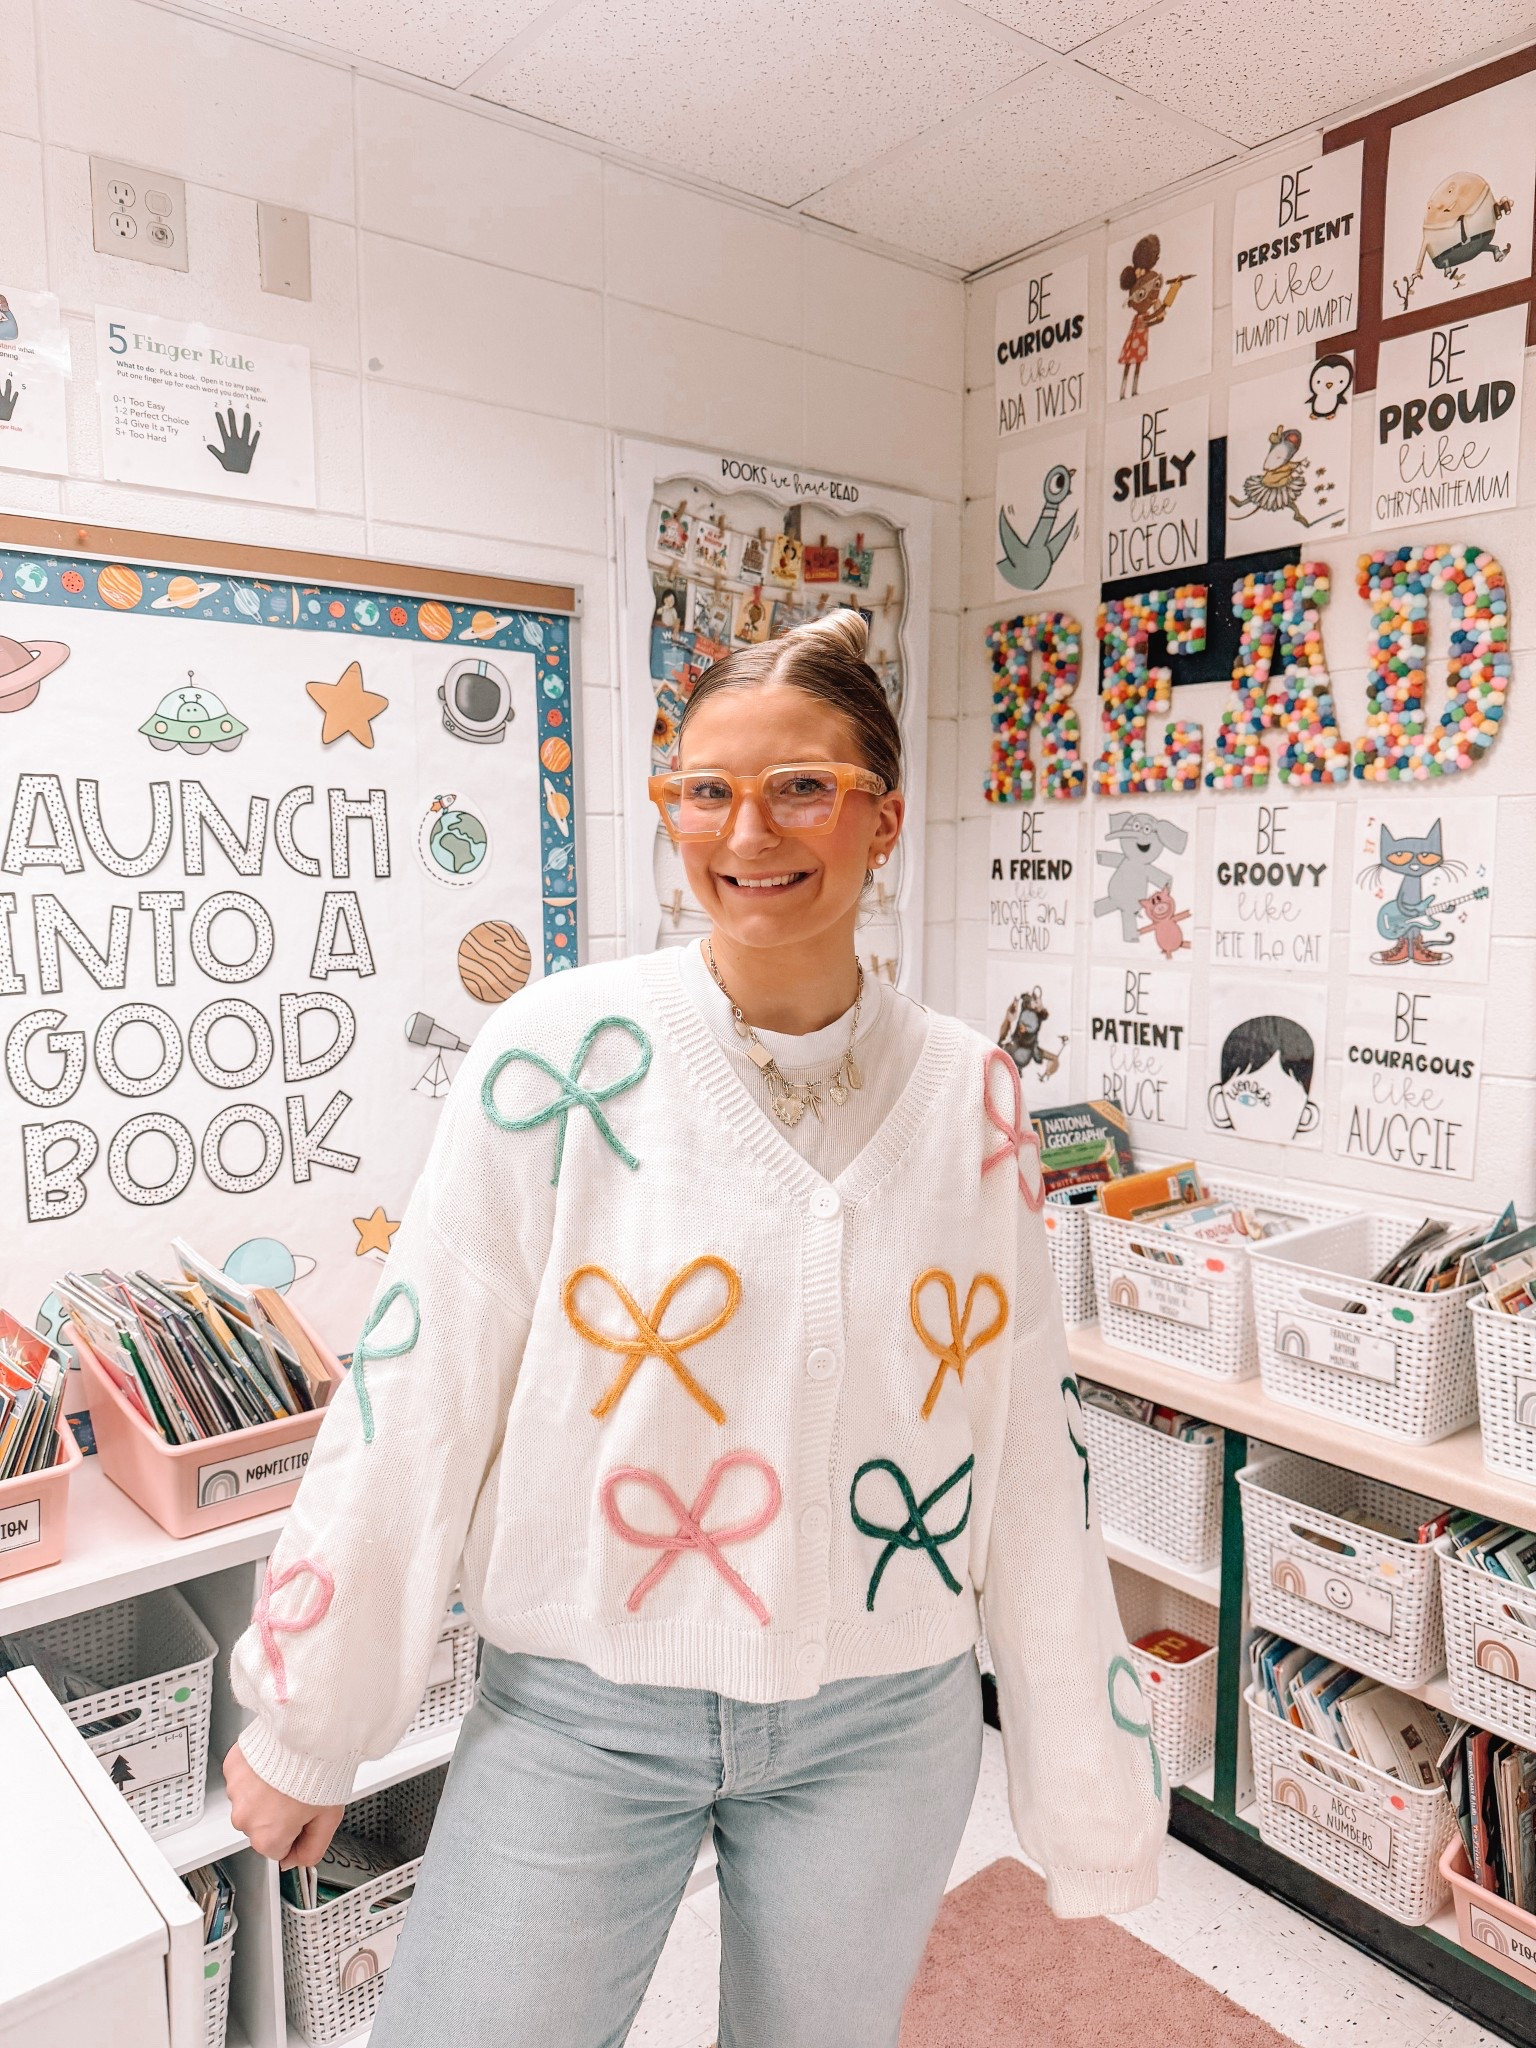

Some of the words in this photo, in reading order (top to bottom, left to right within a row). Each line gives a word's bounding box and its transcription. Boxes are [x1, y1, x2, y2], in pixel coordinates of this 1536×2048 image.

[1278, 165, 1313, 228] BE
[1237, 213, 1354, 272] PERSISTENT
[1028, 272, 1053, 324] BE
[1254, 262, 1334, 311] like
[997, 314, 1084, 365] CURIOUS
[1236, 313, 1290, 354] HUMPTY
[1297, 293, 1354, 335] DUMPTY
[108, 323, 128, 354] 5
[133, 333, 203, 362] Finger
[210, 349, 255, 372] Rule
[1428, 324, 1469, 388] BE
[116, 360, 135, 369] What
[160, 368, 173, 376] Pick
[200, 376, 218, 385] Open
[144, 375, 162, 384] finger
[1020, 357, 1061, 386] like
[113, 394, 127, 404] 0-1
[129, 397, 145, 407] Too
[147, 400, 165, 412] Easy
[115, 406, 128, 415] 1-2
[130, 408, 159, 421] Perfect
[162, 414, 190, 426] Choice
[999, 393, 1026, 436] ADA
[1036, 372, 1084, 422] TWIST
[1380, 380, 1516, 445] PROUD
[115, 417, 128, 426] 3-4
[130, 420, 149, 430] Give
[167, 425, 179, 436] Try
[129, 430, 144, 439] Too
[147, 432, 167, 442] Hard
[1141, 408, 1169, 461] BE
[722, 459, 767, 484] BOOKS
[771, 473, 790, 488] we
[793, 473, 829, 495] have
[830, 481, 859, 502] READ
[1113, 450, 1196, 502] SILLY
[1399, 435, 1490, 484] like
[1130, 494, 1177, 523] like
[1376, 470, 1510, 520] CHRYSANTHEMUM
[1109, 518, 1198, 577] PIGEON
[984, 543, 1512, 803] READ
[1, 773, 391, 878] AUNCH
[1020, 811, 1044, 853] BE
[1257, 806, 1289, 855] BE
[992, 858, 1003, 880] A
[1010, 859, 1072, 881] FRIEND
[1015, 882, 1047, 900] like
[1218, 862, 1327, 887] GROOVY
[991, 900, 1030, 926] PIGGIE
[1037, 900, 1068, 926] and
[1238, 891, 1302, 923] like
[0, 891, 275, 996] INTO
[310, 891, 376, 980] A
[1216, 930, 1245, 958] PETE
[1293, 934, 1322, 963] CAT
[1124, 970, 1152, 1015] BE
[1092, 1018, 1184, 1050] PATIENT
[1395, 992, 1431, 1045] BE
[4, 992, 356, 1108] GOOD
[1110, 1044, 1162, 1076] like
[1349, 1045, 1475, 1079] COURAGOUS
[1372, 1072, 1444, 1111] like
[1045, 1114, 1094, 1134] NATIONAL
[1048, 1127, 1108, 1148] GEOGRAPHIC
[1347, 1105, 1462, 1171] AUGGIE
[21, 1090, 361, 1224] BOOK
[265, 1392, 280, 1410] WHY
[246, 1452, 312, 1483] NONFICTIO
[1312, 1804, 1320, 1821] &
[1327, 1813, 1372, 1850] NUMBERS
[1332, 1797, 1356, 1822] ABCS
